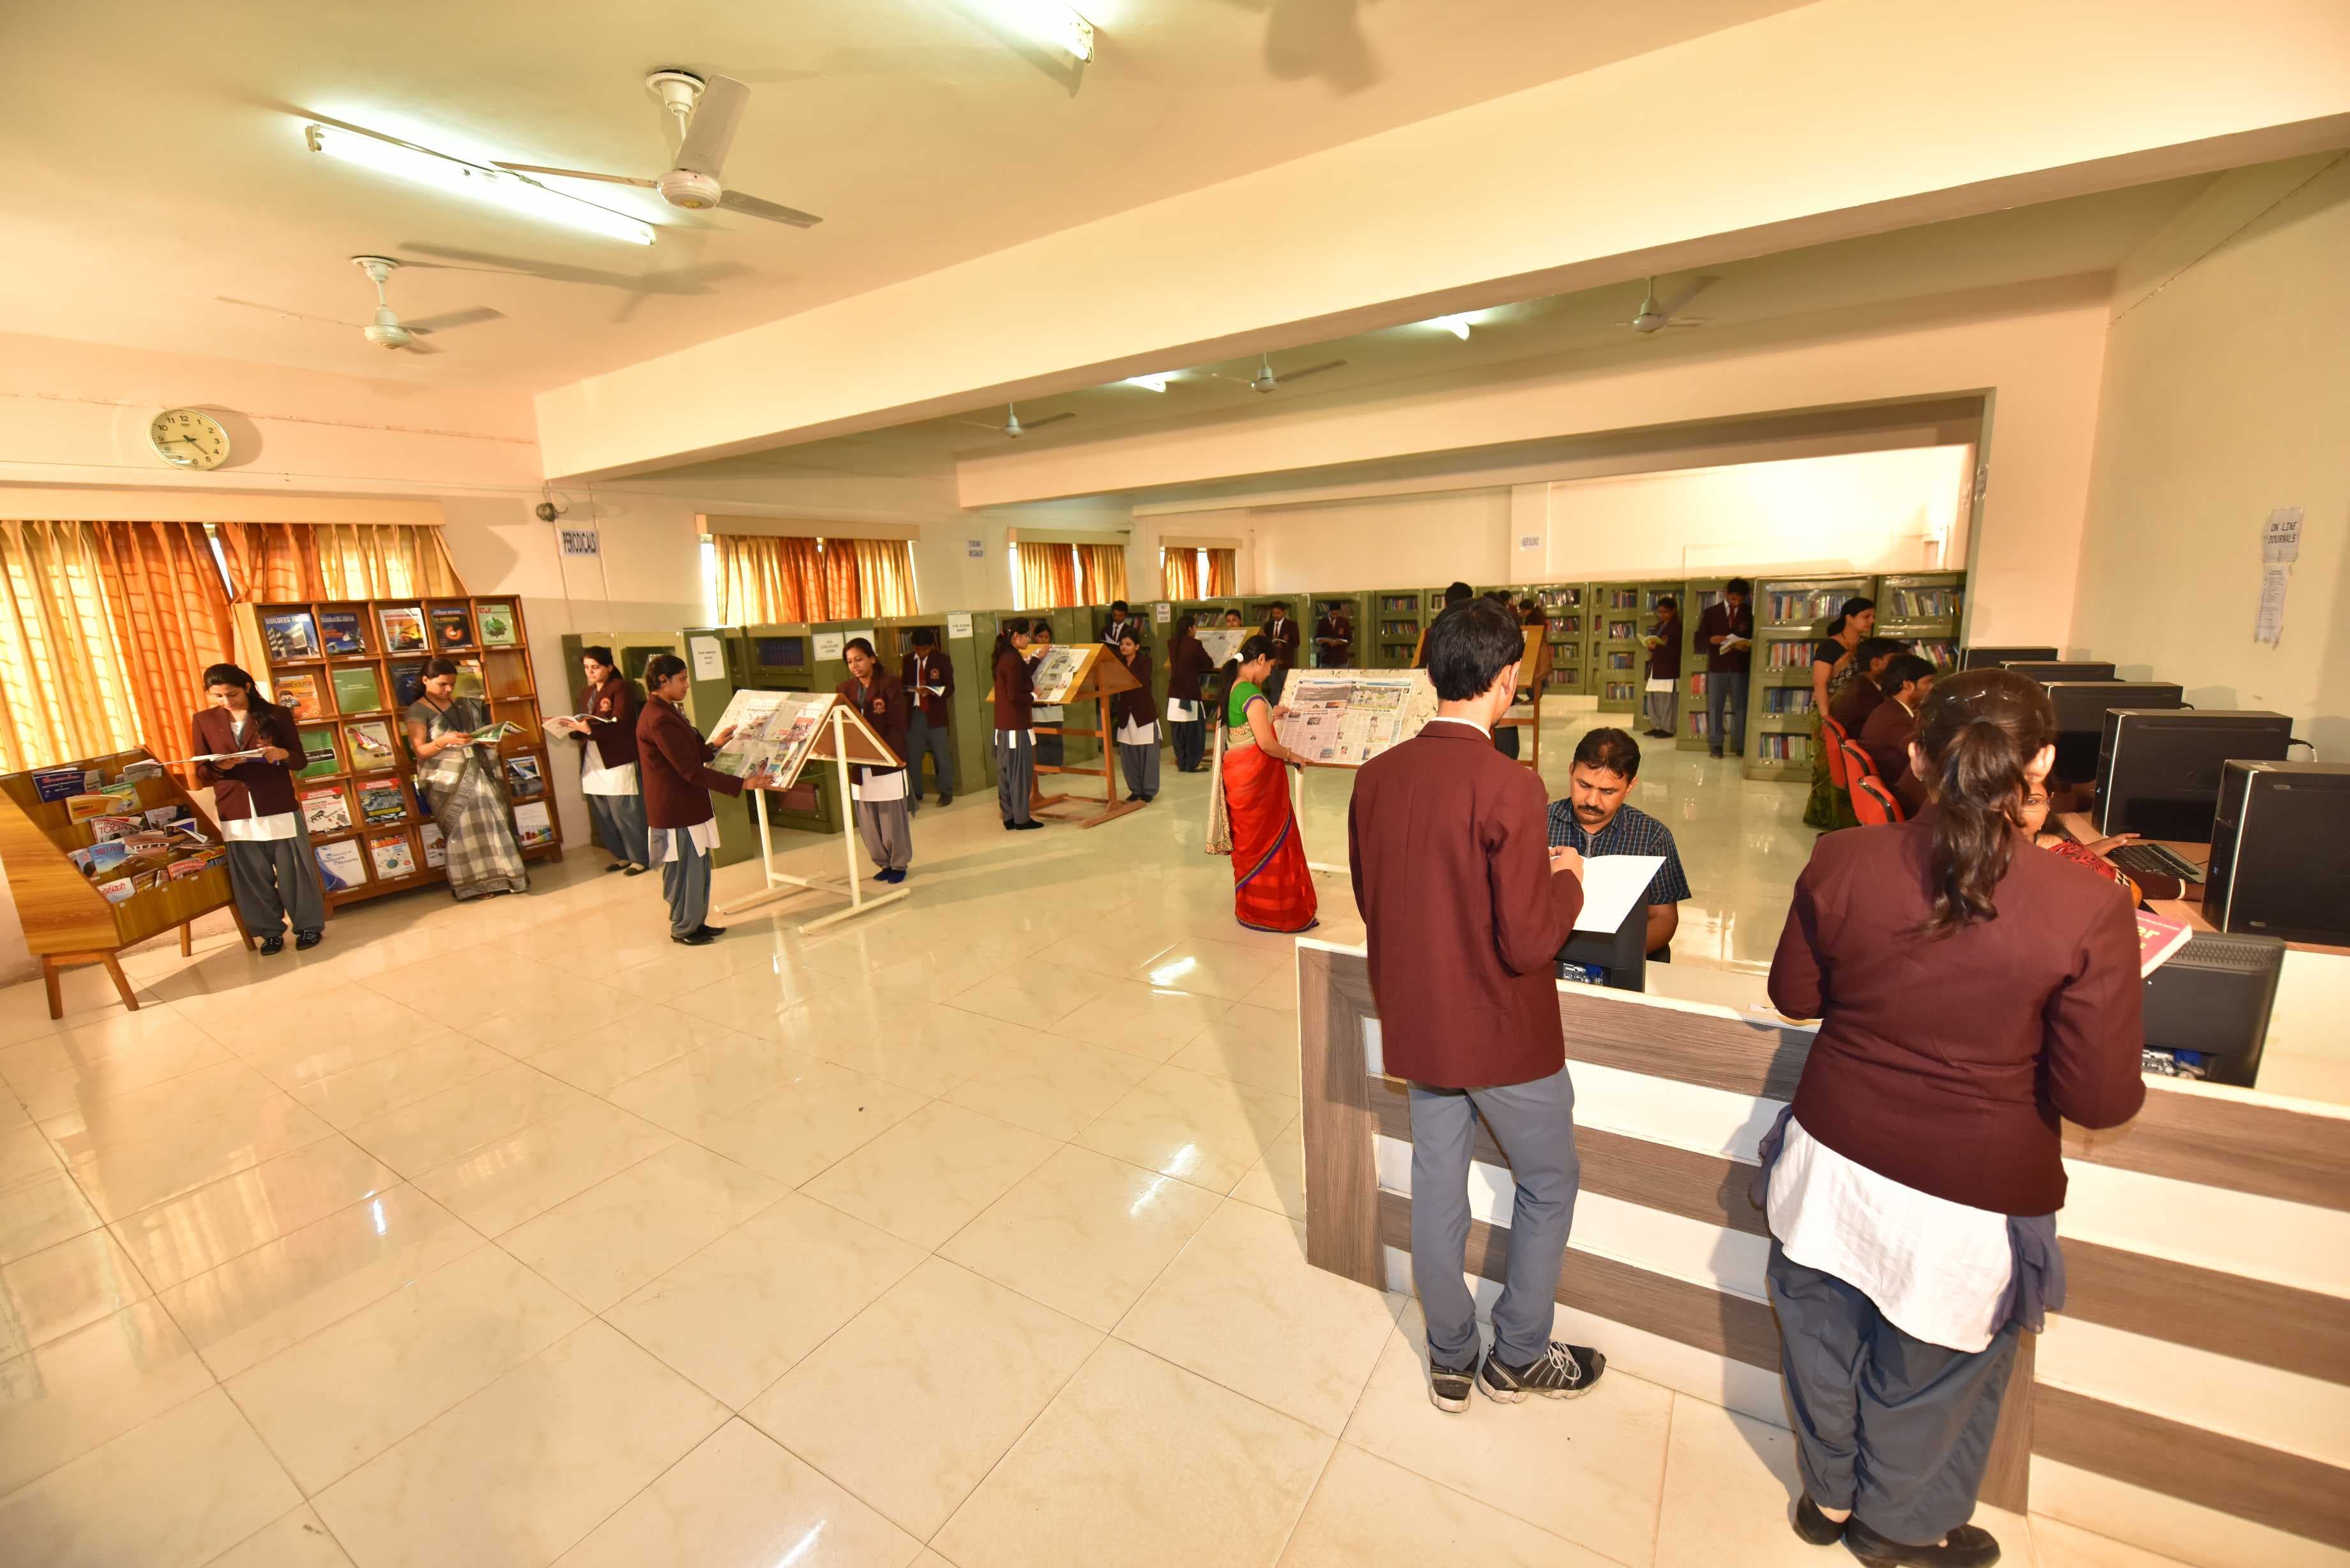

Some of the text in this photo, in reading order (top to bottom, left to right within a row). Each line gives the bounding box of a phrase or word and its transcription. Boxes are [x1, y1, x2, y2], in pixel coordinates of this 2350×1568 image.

[2271, 522, 2298, 532] ON LINE
[563, 532, 596, 553] PERIODICALS
[2268, 534, 2296, 544] JOURNALS
